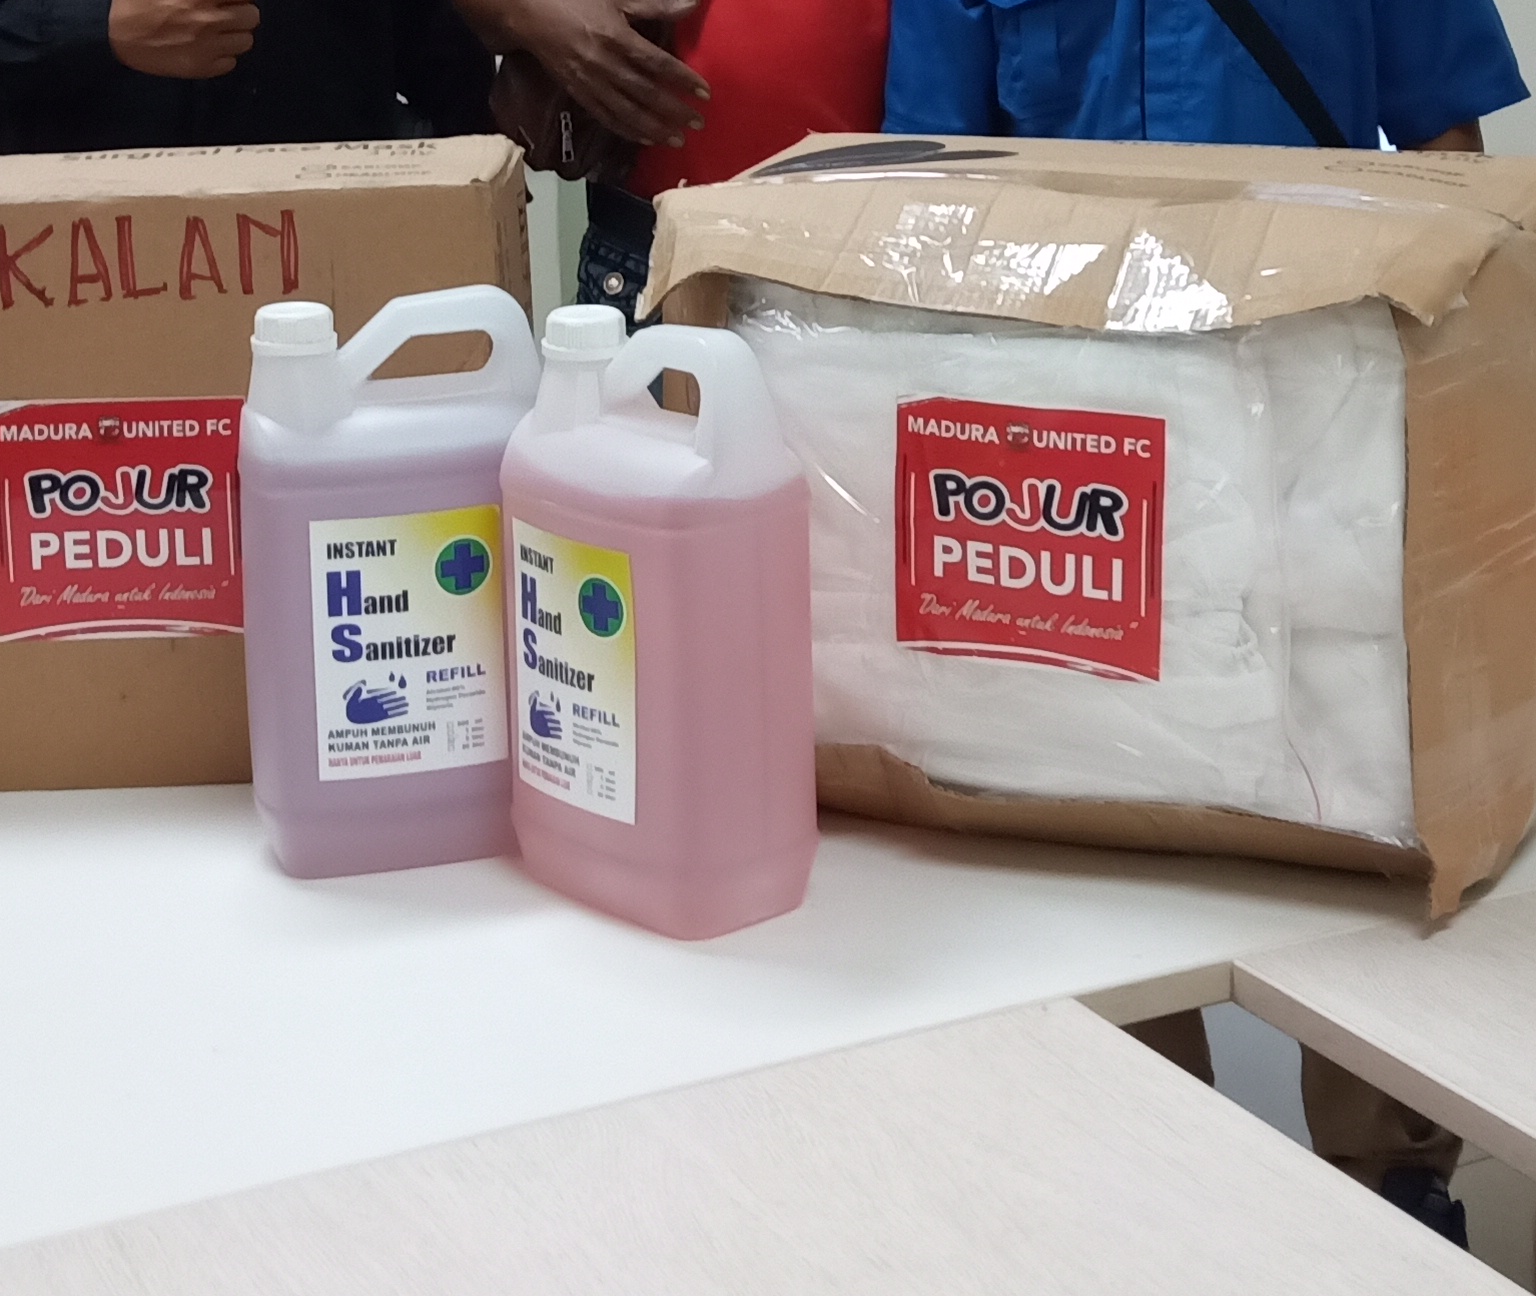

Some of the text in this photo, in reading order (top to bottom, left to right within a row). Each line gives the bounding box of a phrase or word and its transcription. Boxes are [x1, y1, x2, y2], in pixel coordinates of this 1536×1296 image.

[0, 418, 232, 442] MADURA UNITED FC
[907, 415, 1151, 458] MADURA UNITED FC
[24, 464, 213, 518] POJUR
[929, 468, 1129, 542] POJUR
[30, 527, 213, 570] PEDULI
[326, 539, 397, 560] INSTANT
[520, 544, 554, 574] INSTANT
[933, 535, 1124, 602] PEDULI
[326, 570, 409, 617] Hand
[521, 572, 562, 636] Hand
[331, 623, 456, 663] Sanitizer
[523, 628, 595, 693] Sanitizer
[426, 663, 486, 684] REFILL
[328, 727, 368, 740] AMPUH
[371, 721, 437, 737] MEMBUNUH
[572, 703, 620, 728] REFILL
[328, 735, 431, 753] KUMAN TANPA AIR
